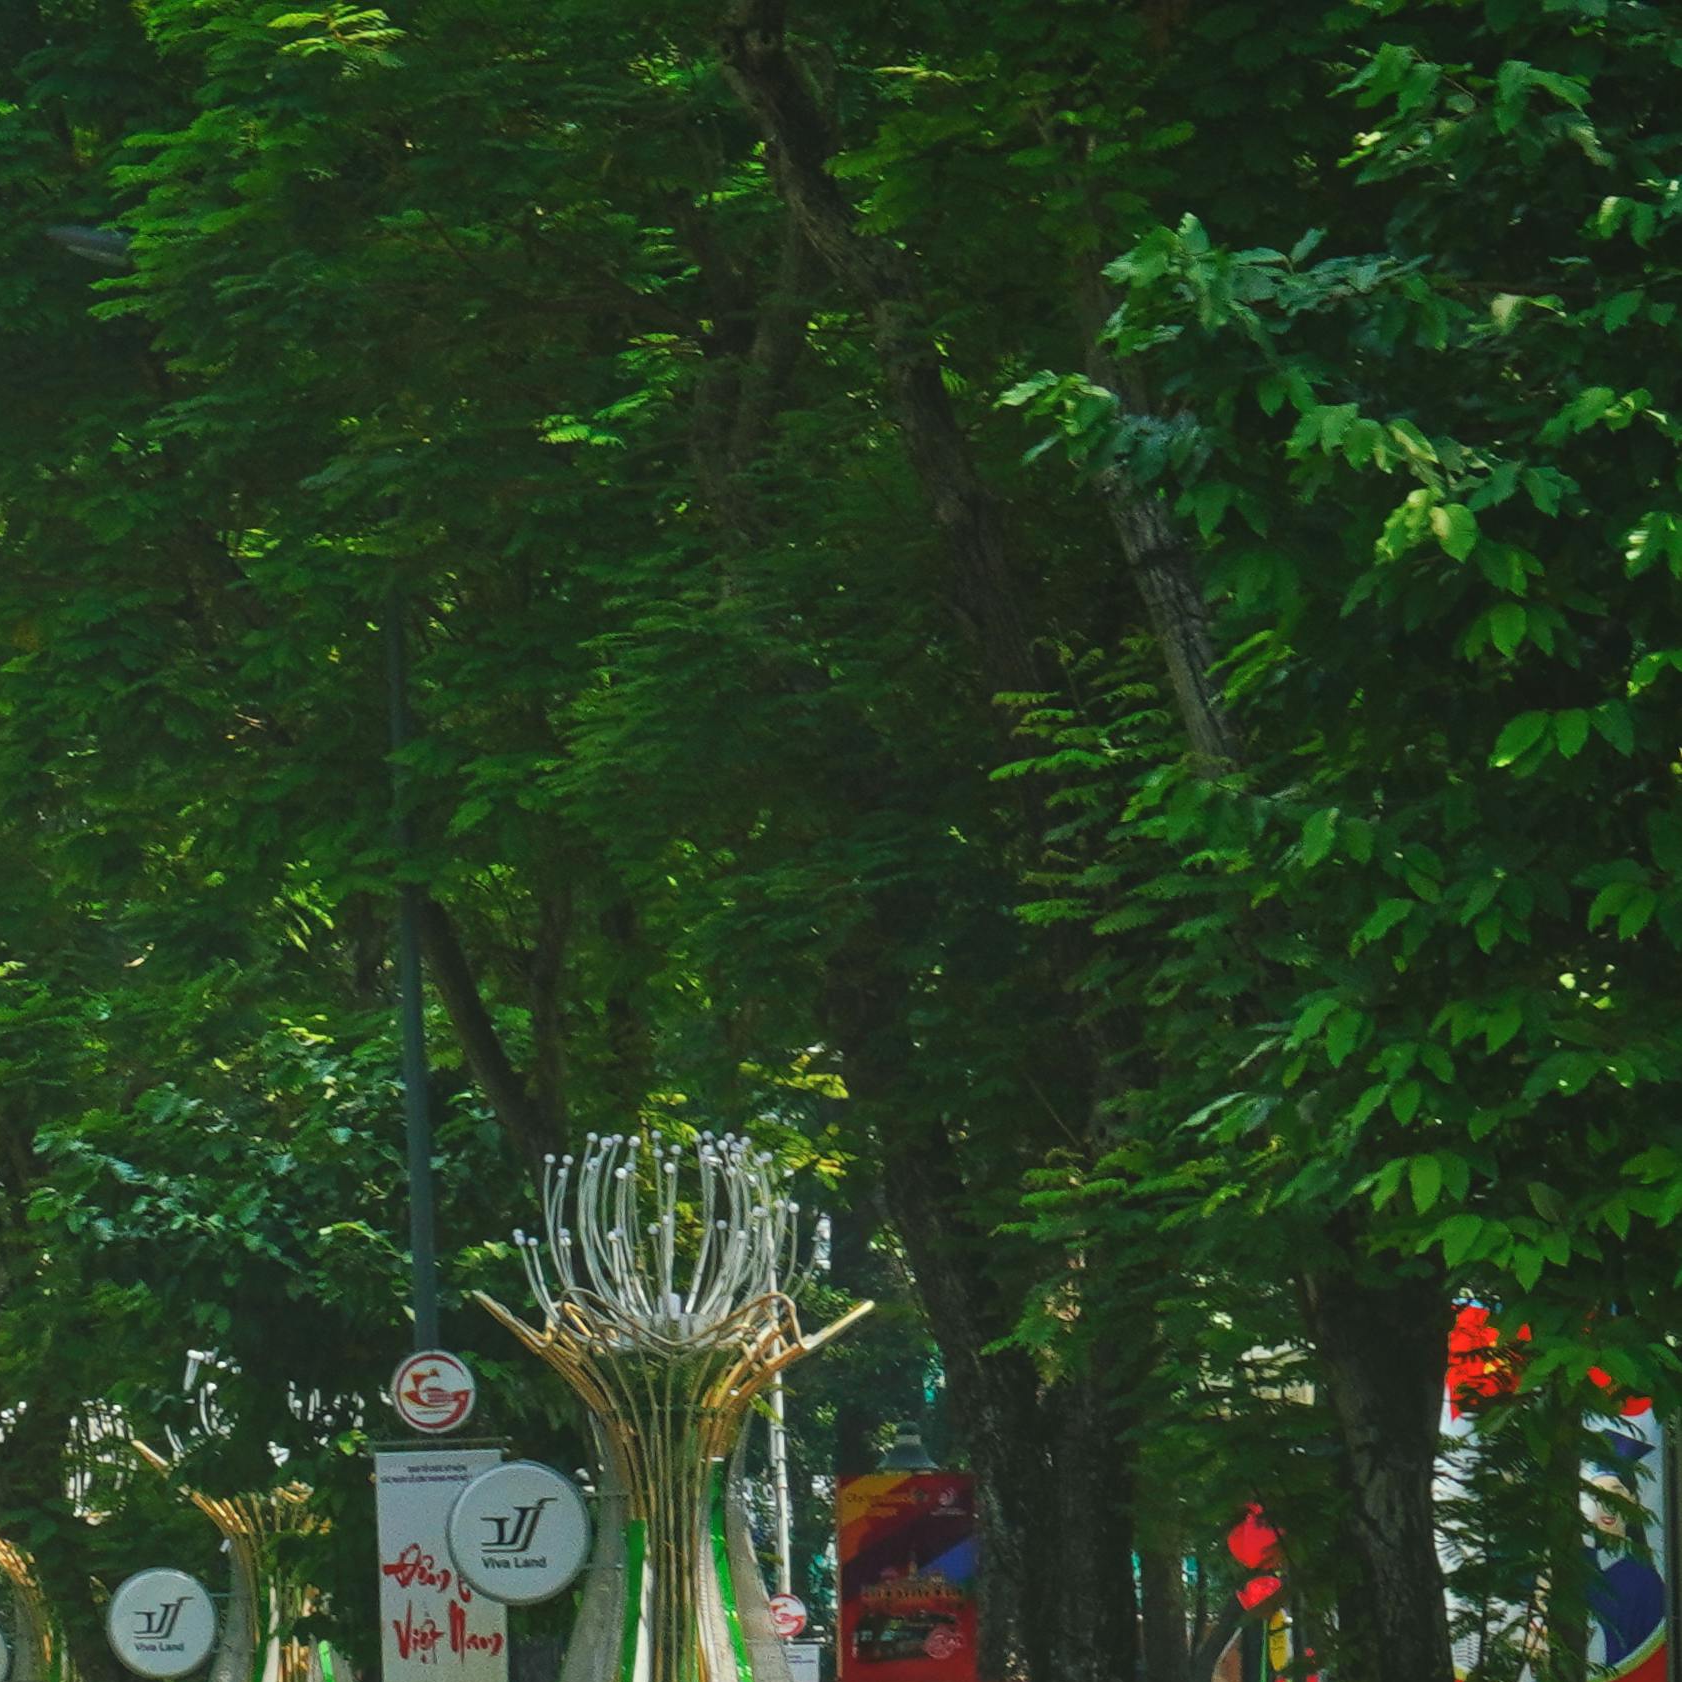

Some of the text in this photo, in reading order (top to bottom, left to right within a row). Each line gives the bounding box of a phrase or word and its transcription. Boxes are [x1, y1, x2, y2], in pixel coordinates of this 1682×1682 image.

[481, 1556, 548, 1569] Viva Land
[449, 1599, 504, 1664] Nam
